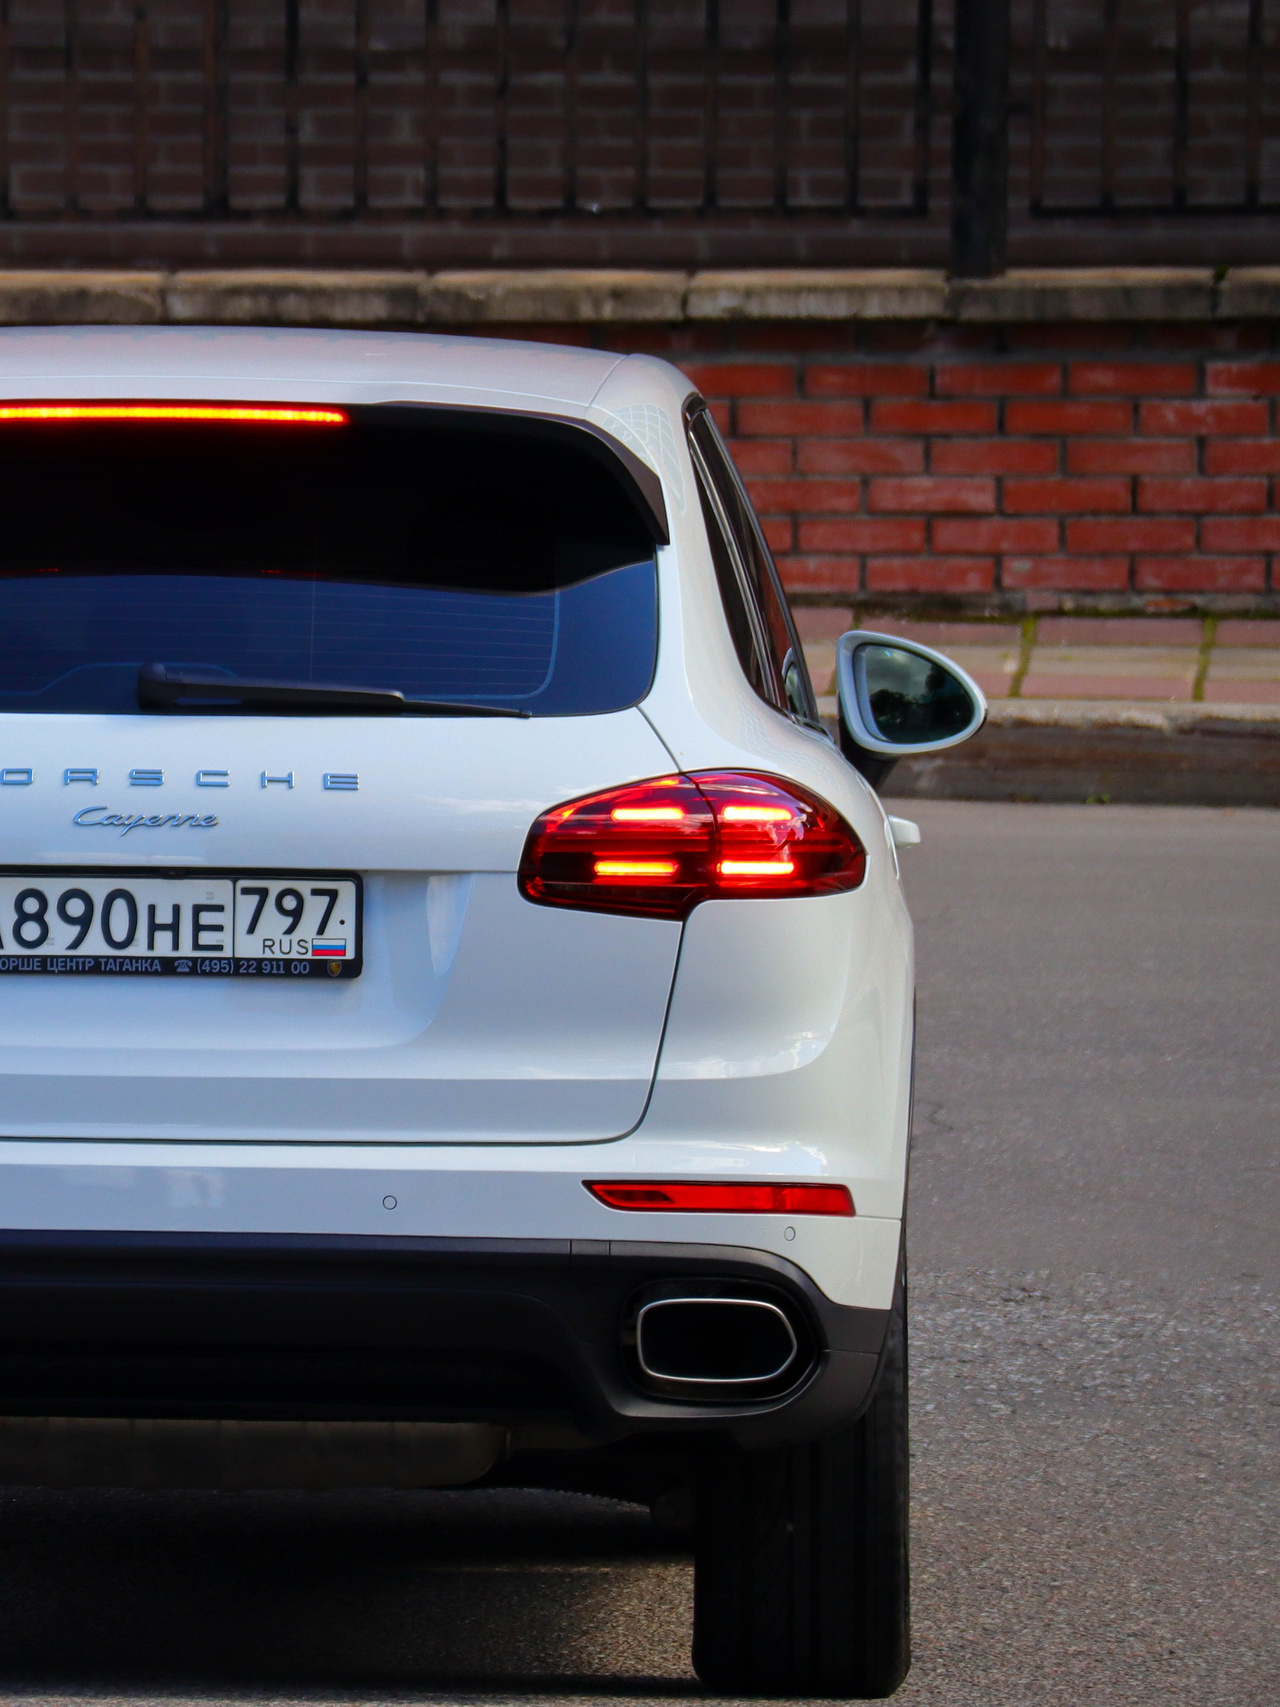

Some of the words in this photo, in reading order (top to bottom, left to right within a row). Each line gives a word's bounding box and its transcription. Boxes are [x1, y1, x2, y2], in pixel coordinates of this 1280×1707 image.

[73, 805, 219, 837] Cayenne
[240, 887, 339, 936] 797
[261, 938, 309, 956] RUS
[46, 958, 95, 974] ЦЕНТР
[98, 959, 162, 973] ТАГАНКА
[196, 959, 235, 975] (495)
[239, 960, 257, 974] 22
[261, 961, 286, 975] 911
[291, 961, 310, 975] 00
